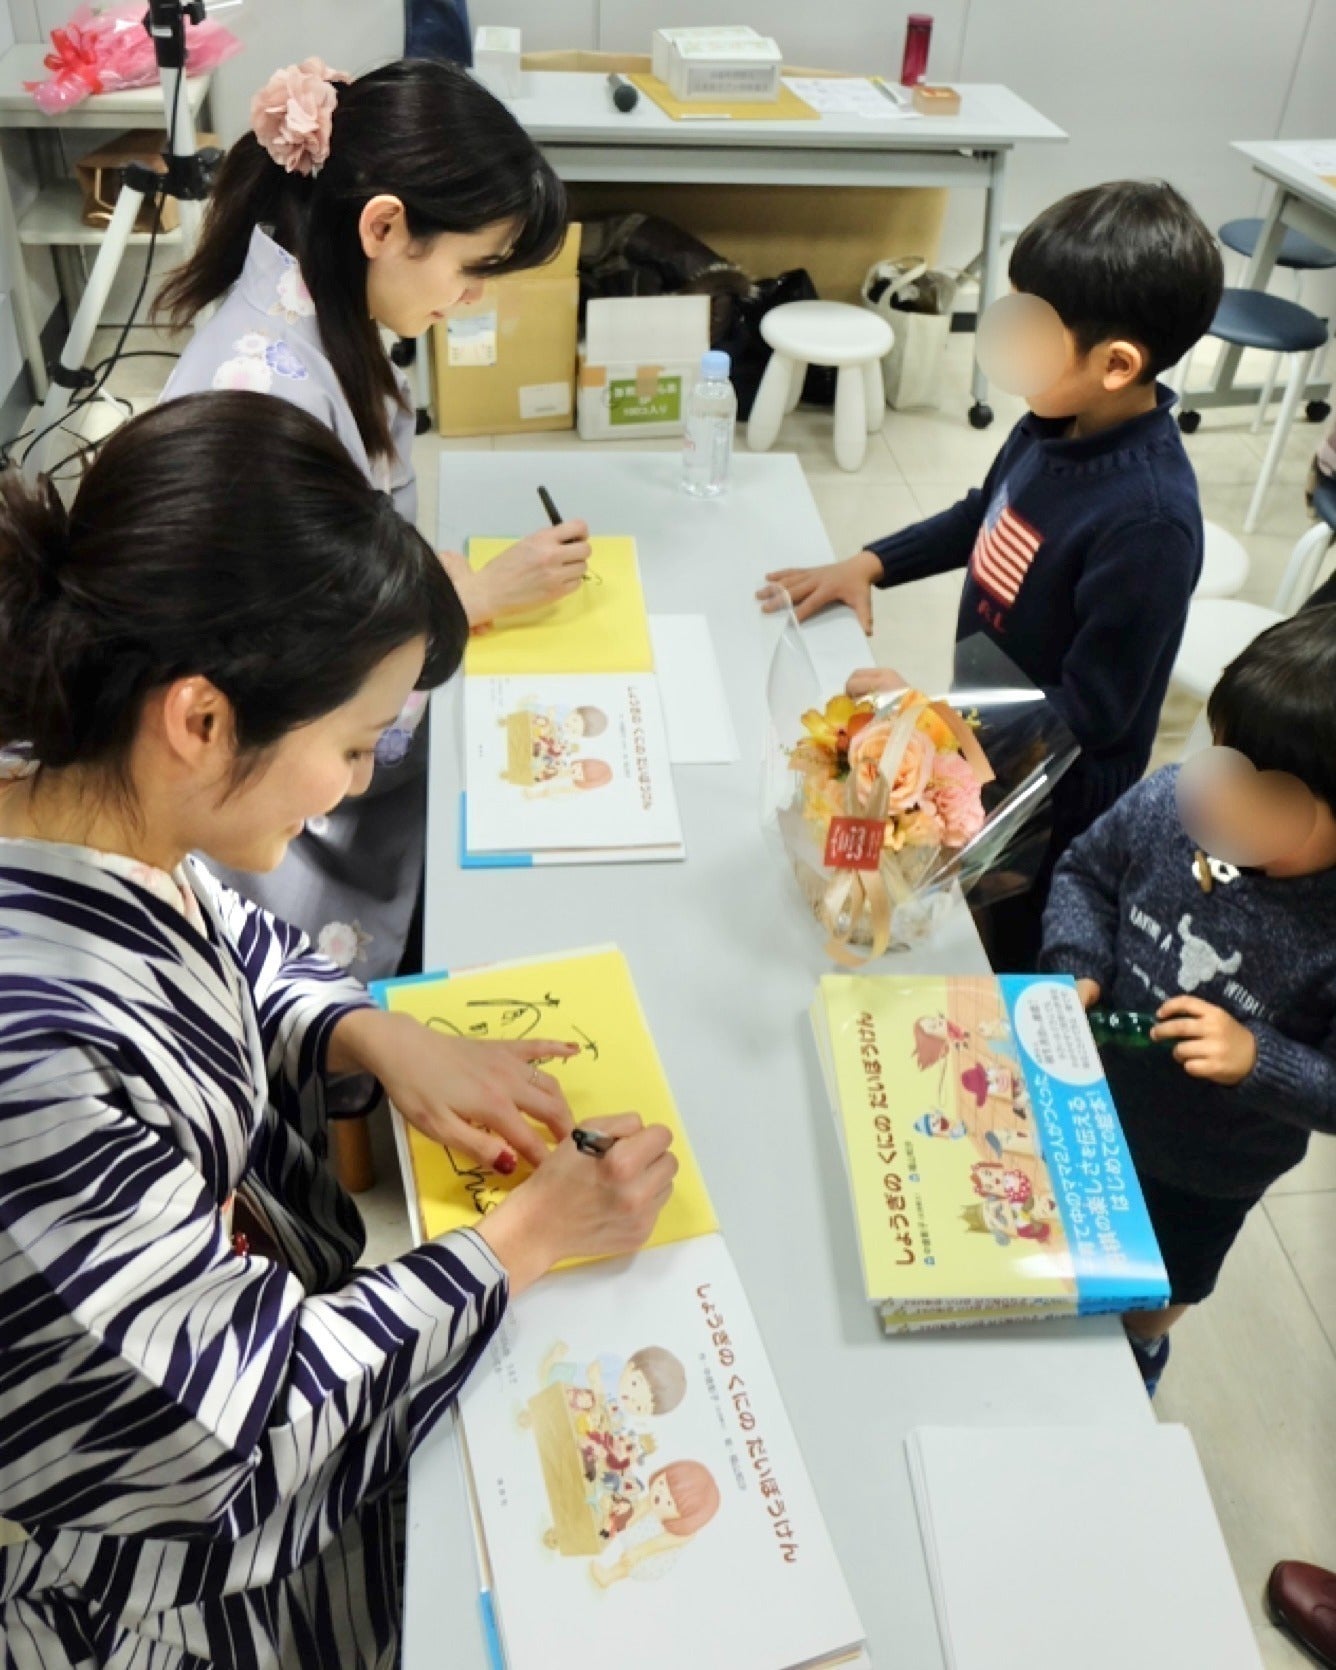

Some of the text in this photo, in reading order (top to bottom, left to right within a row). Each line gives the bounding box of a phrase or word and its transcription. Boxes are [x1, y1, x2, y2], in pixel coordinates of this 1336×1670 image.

[855, 1011, 889, 1109] だいぼうけん
[873, 1114, 898, 1164] くにの
[882, 1172, 916, 1266] しょうぎの
[696, 1282, 736, 1368] しょうぎの
[728, 1374, 756, 1432] くにの
[745, 1437, 800, 1564] だいぼうけん
